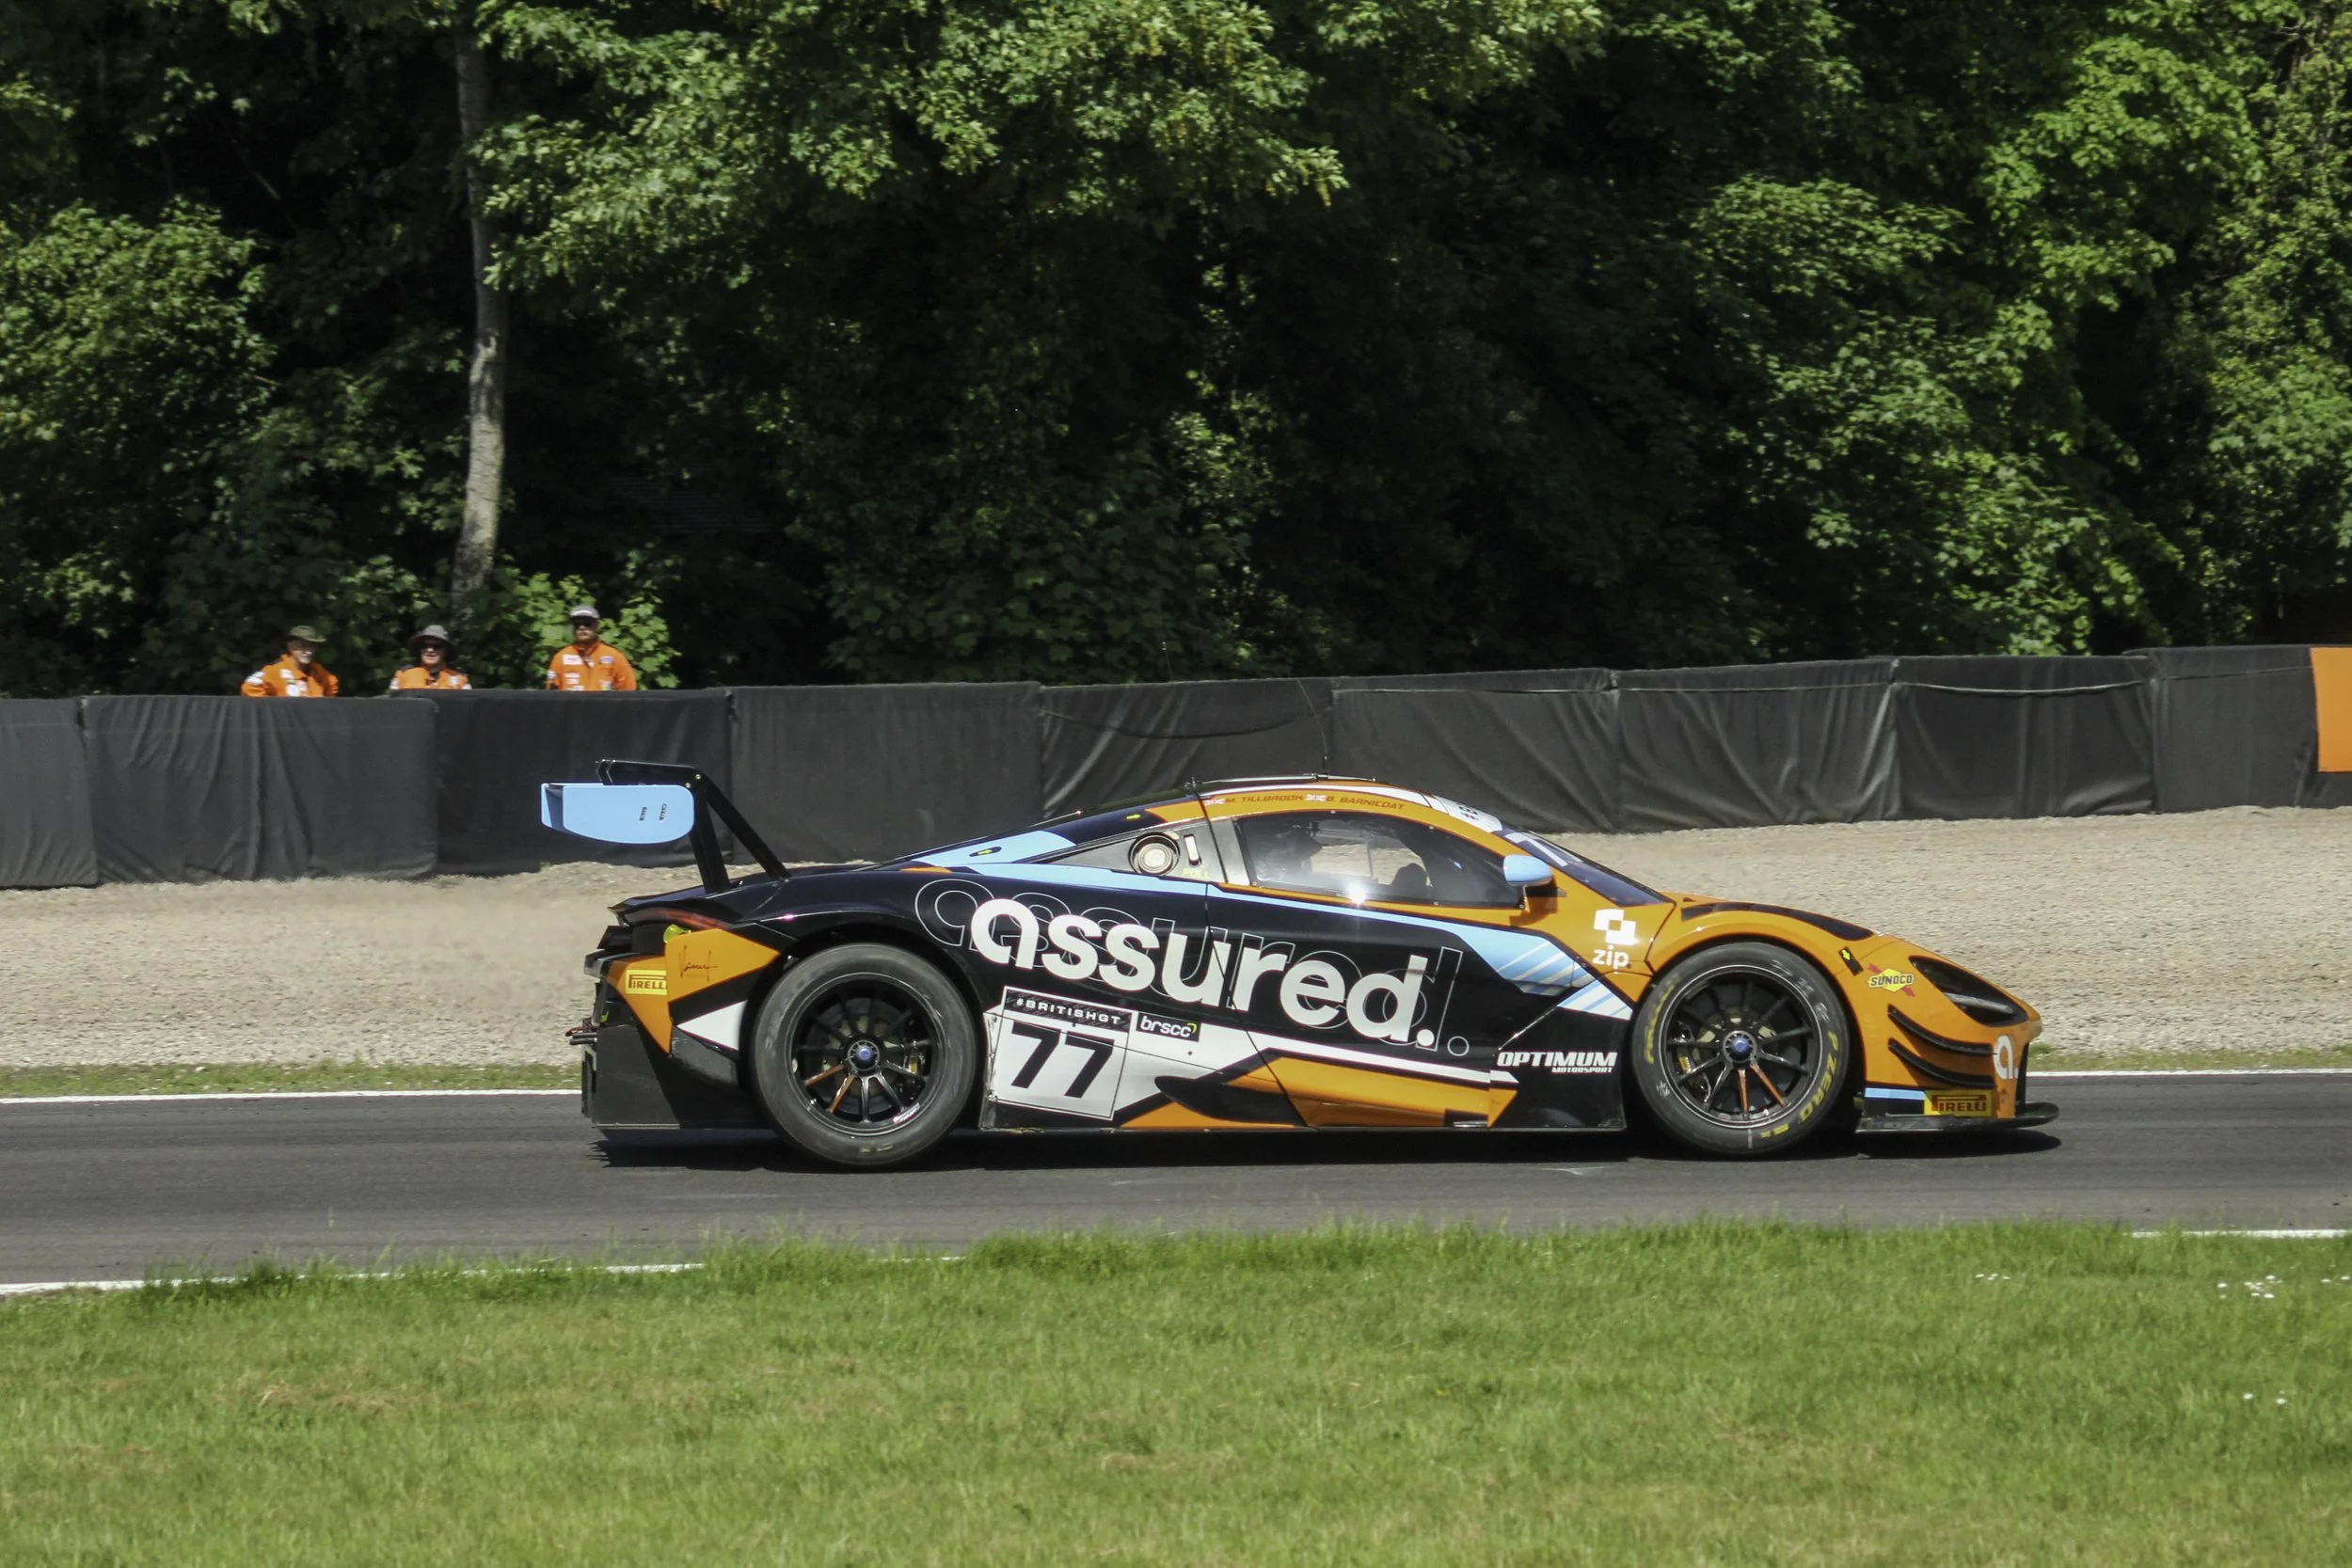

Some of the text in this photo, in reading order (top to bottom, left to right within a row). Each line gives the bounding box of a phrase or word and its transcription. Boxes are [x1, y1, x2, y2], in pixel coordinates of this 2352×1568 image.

[1592, 944, 1629, 974] zip
[971, 898, 1436, 1047] assured.
[1870, 974, 1913, 986] SUNOCO
[1016, 997, 1122, 1025] #BRITISHGT
[1140, 1015, 1192, 1037] brscc
[1010, 1020, 1115, 1099] 77
[1497, 1052, 1618, 1067] OPTIMUM
[1931, 1094, 1987, 1112] PIRELLI
